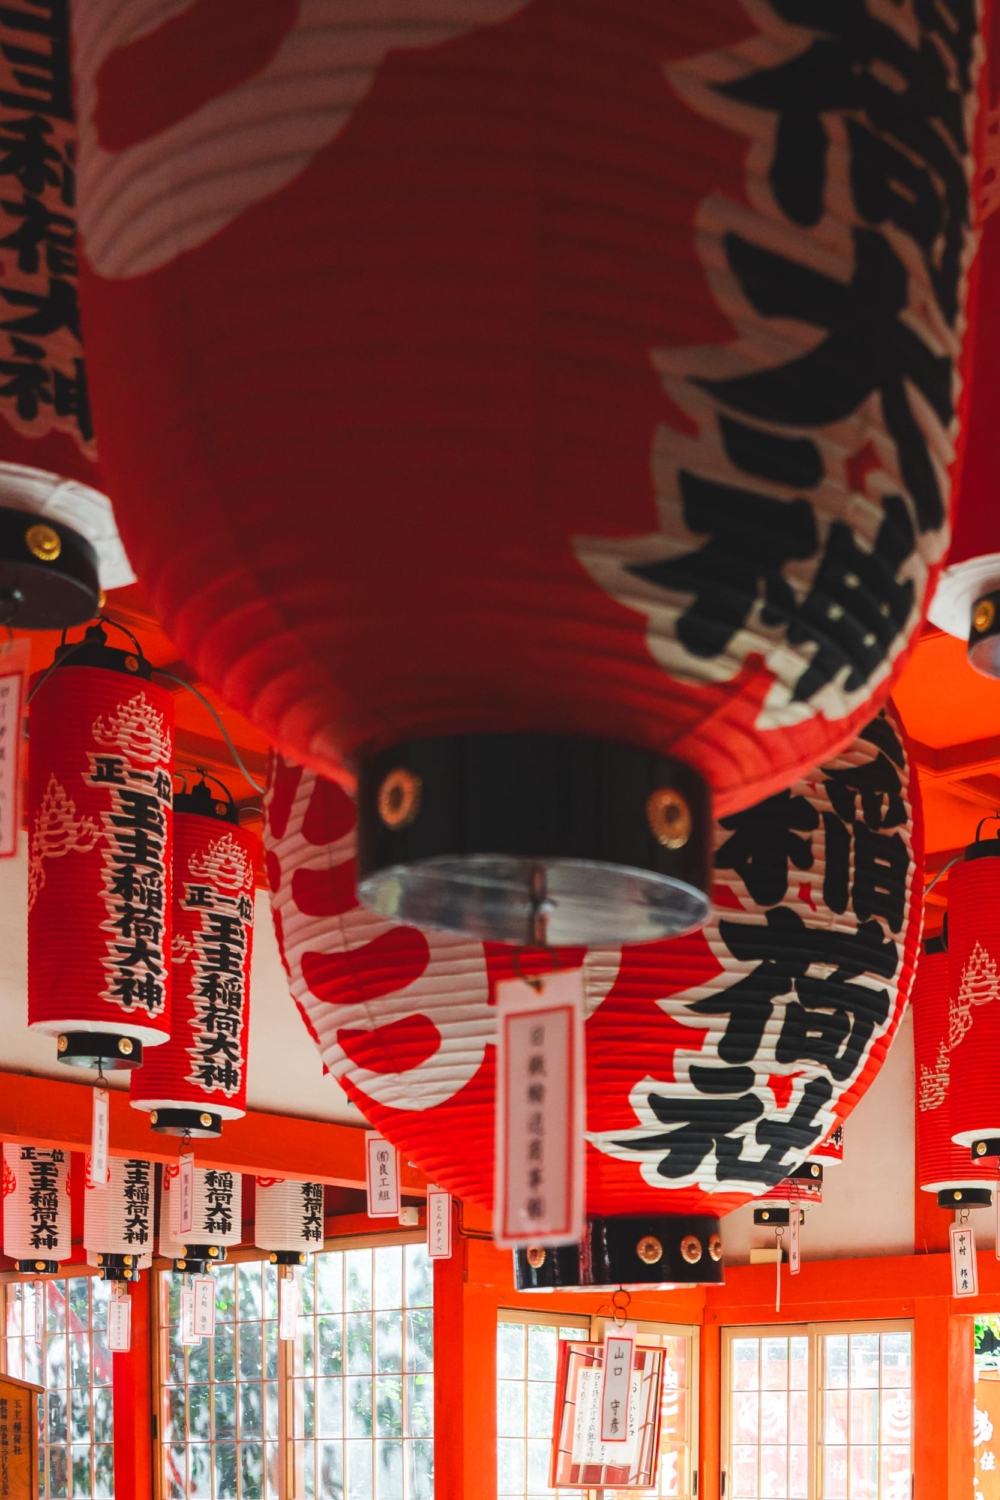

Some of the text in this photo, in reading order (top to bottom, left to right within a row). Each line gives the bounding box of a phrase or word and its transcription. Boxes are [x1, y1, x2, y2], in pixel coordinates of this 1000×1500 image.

[90, 757, 171, 799] 正一位
[109, 788, 164, 1011] 玉主稲荷大神
[185, 886, 253, 922] 正一位
[195, 912, 245, 1090] 玉主稲荷大神
[20, 1146, 65, 1164] 正一位
[376, 1150, 390, 1201] ㈲良工組
[28, 1161, 58, 1250] 玉主稲荷大神
[202, 1170, 234, 1236] 稲荷大神
[300, 1181, 324, 1242] 稲荷大神
[958, 1235, 967, 1256] 中村
[613, 1347, 624, 1377] 山口
